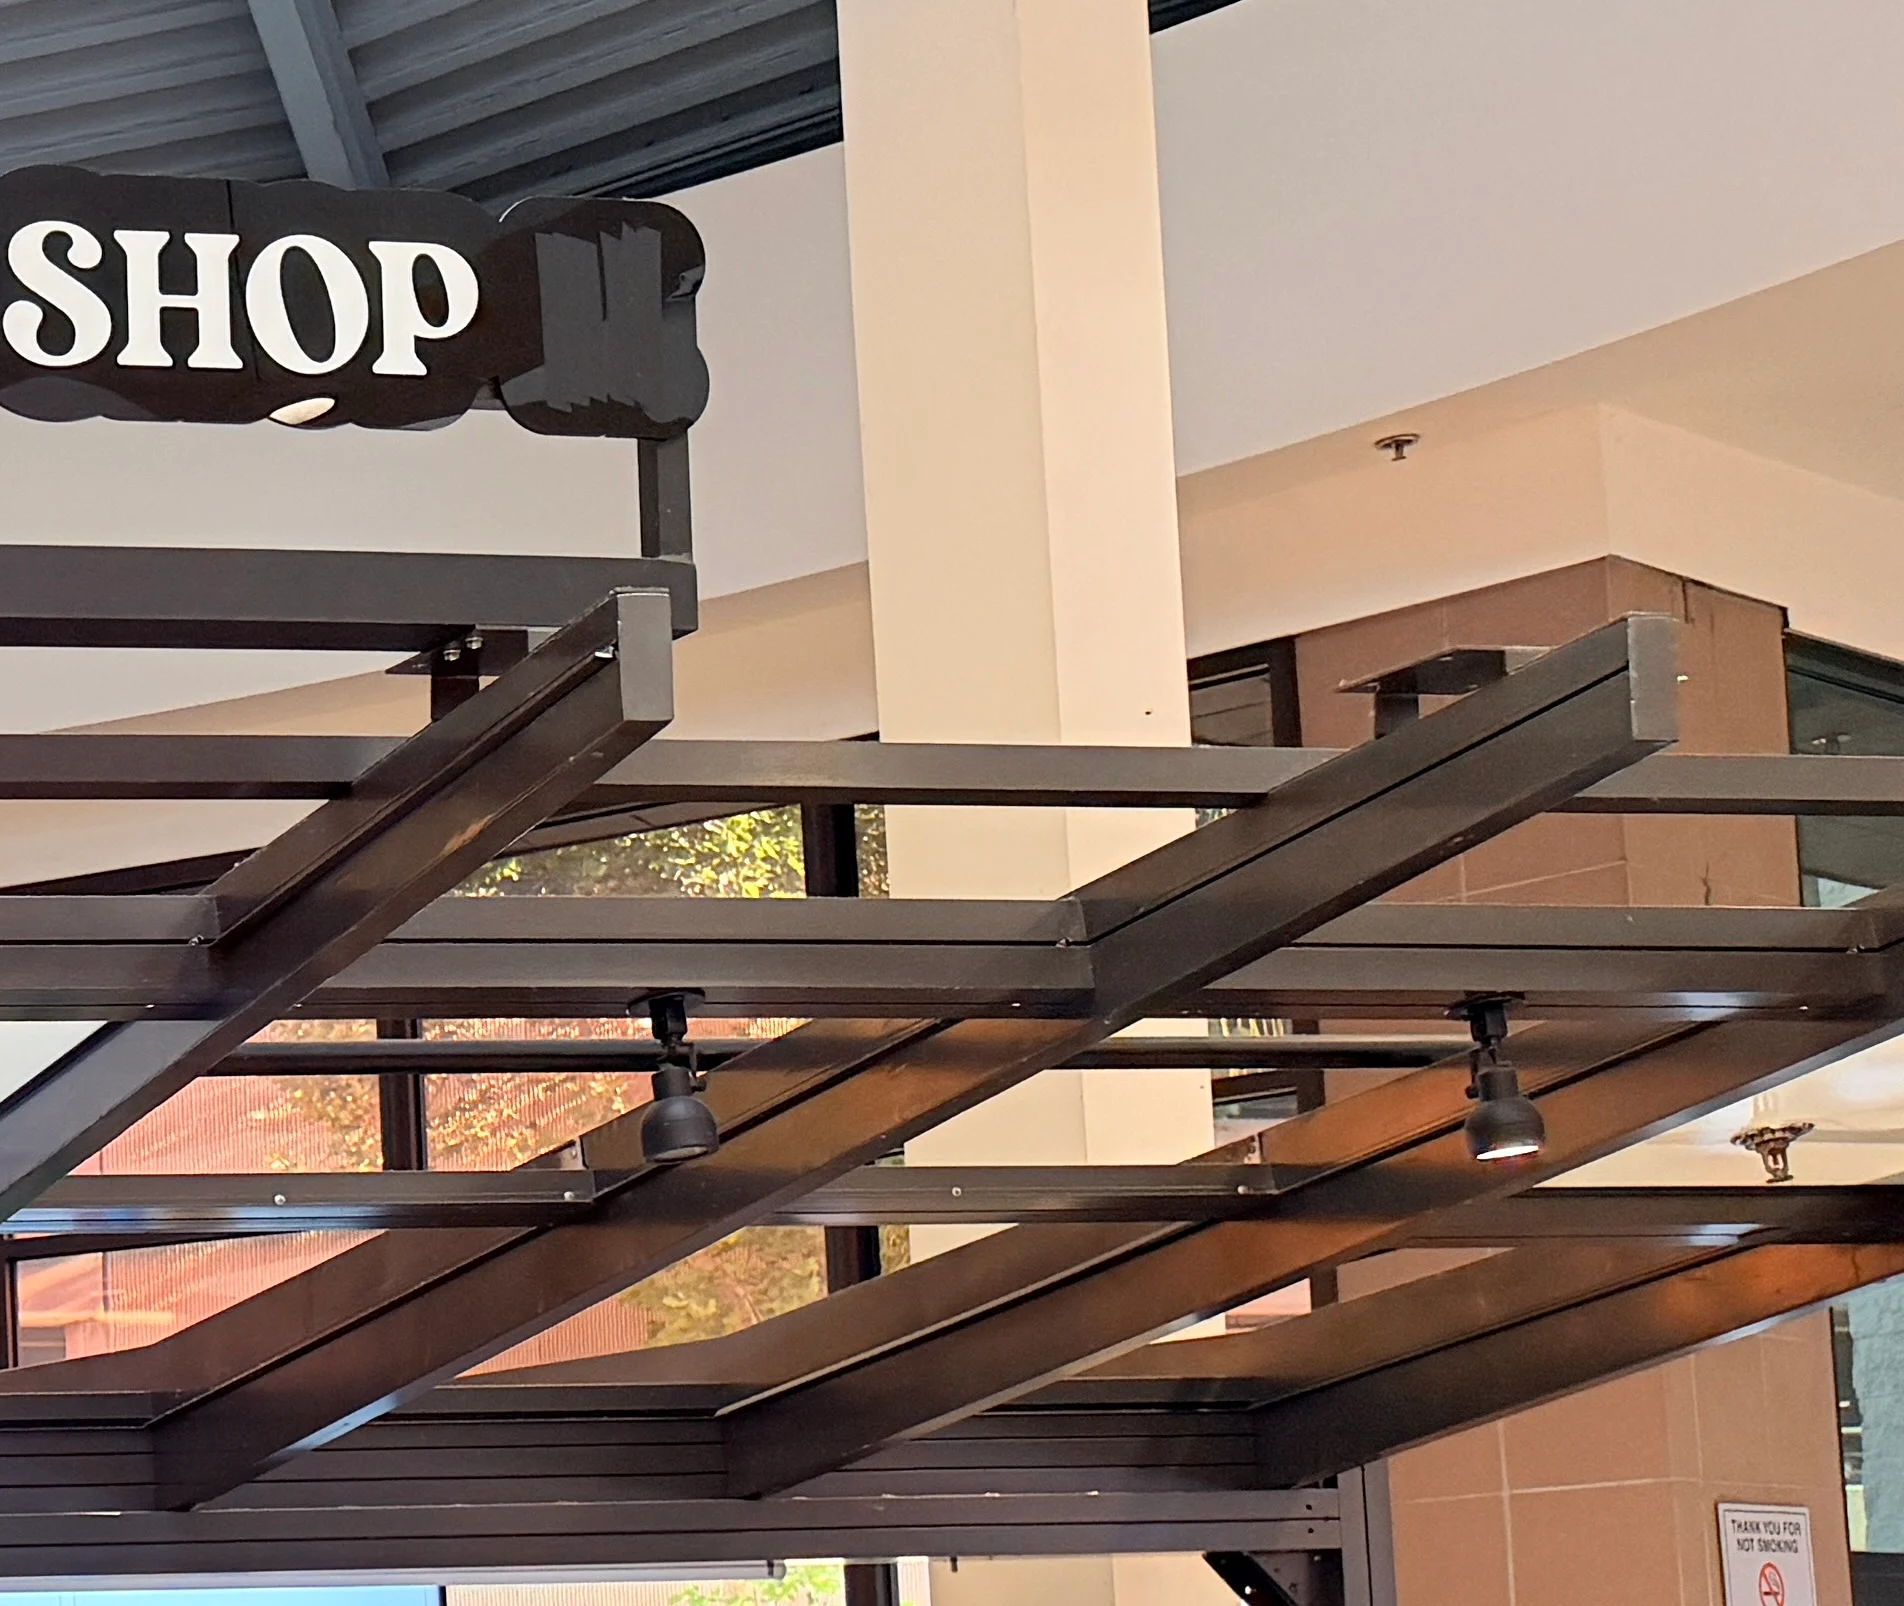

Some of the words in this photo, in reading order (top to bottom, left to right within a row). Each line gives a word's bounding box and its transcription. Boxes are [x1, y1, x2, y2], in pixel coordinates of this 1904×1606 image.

[1, 216, 481, 378] SHOP
[1731, 1519, 1761, 1535] THANK
[1764, 1520, 1781, 1536] YOU
[1783, 1522, 1802, 1537] FOR
[1737, 1538, 1754, 1552] NOT
[1758, 1538, 1799, 1554] SMOKING
